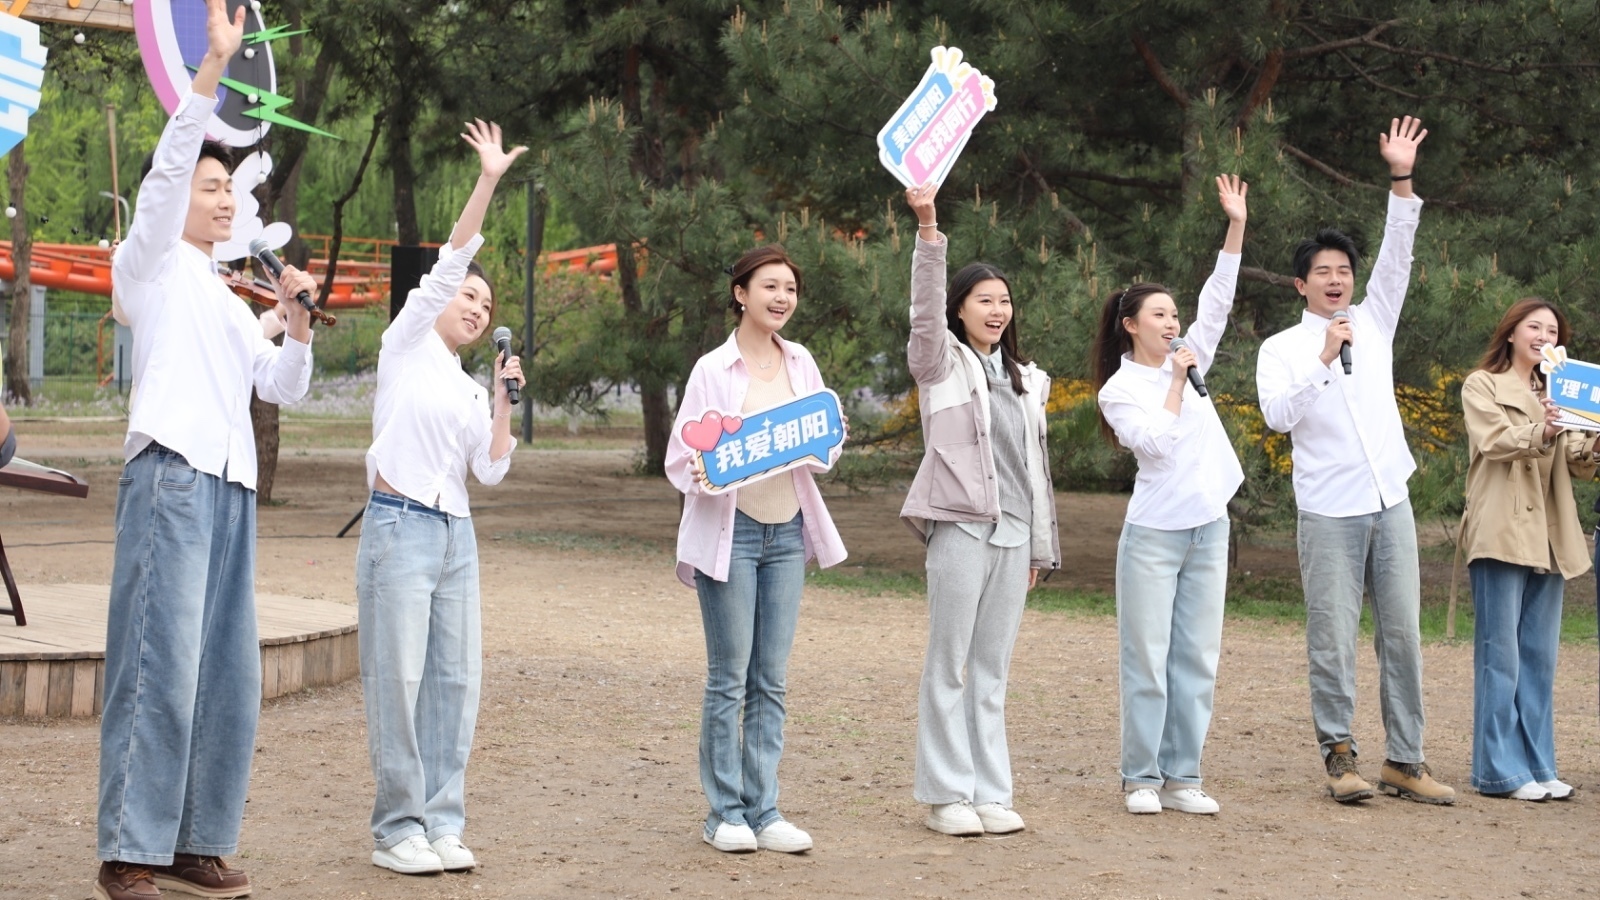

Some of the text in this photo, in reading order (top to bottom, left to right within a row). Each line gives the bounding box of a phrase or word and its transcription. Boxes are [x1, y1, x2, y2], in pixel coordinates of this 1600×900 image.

[891, 83, 946, 152] 美丽朝阳
[914, 88, 977, 171] 你我同行
[715, 409, 829, 474] 我爱朝阳
